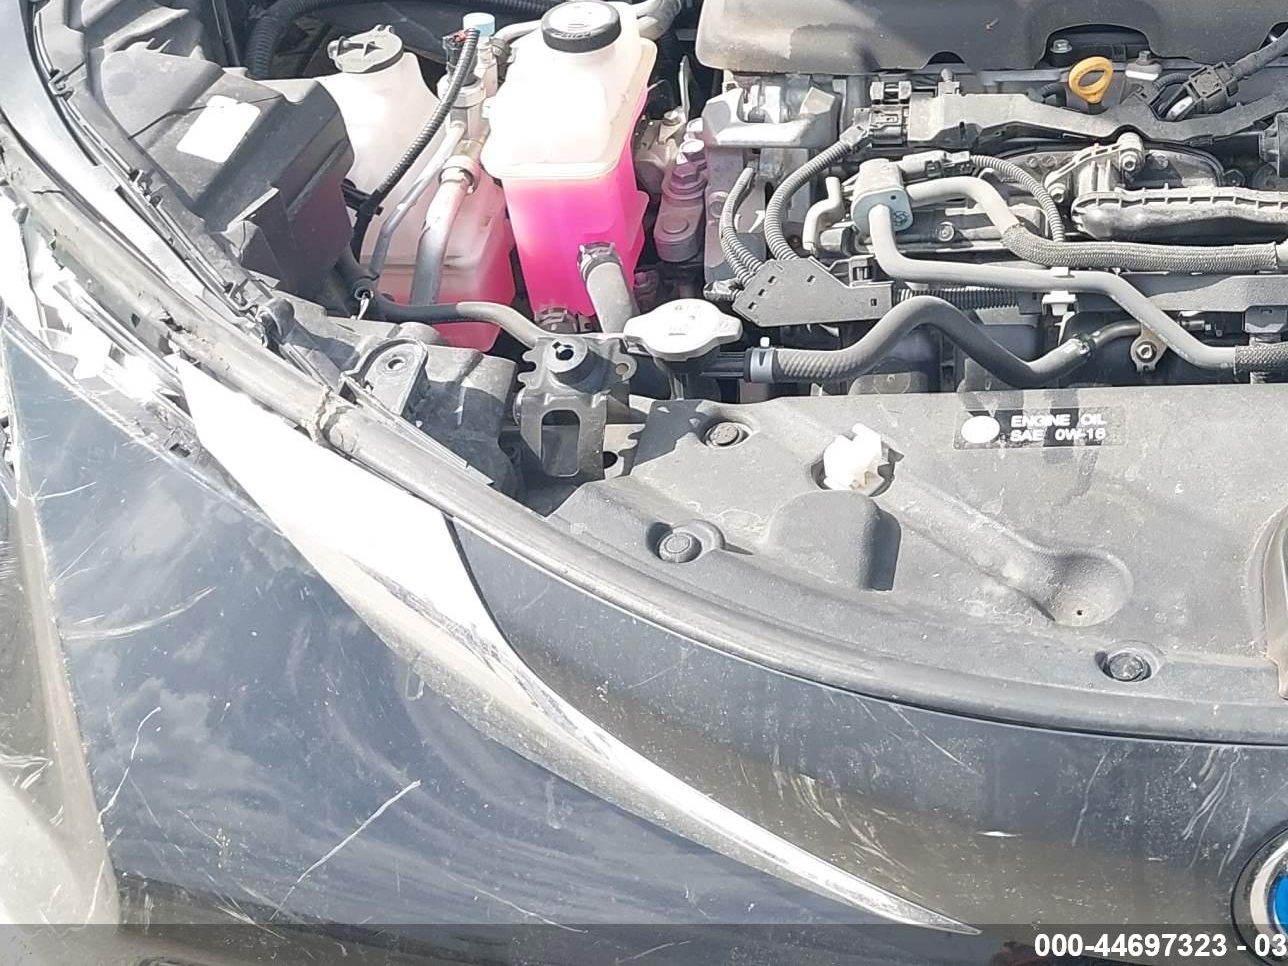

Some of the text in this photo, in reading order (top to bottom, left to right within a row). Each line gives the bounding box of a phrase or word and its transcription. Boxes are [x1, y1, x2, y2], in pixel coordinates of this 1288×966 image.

[1010, 413, 1108, 427] ENGINE OIL
[1009, 430, 1045, 442] SAE
